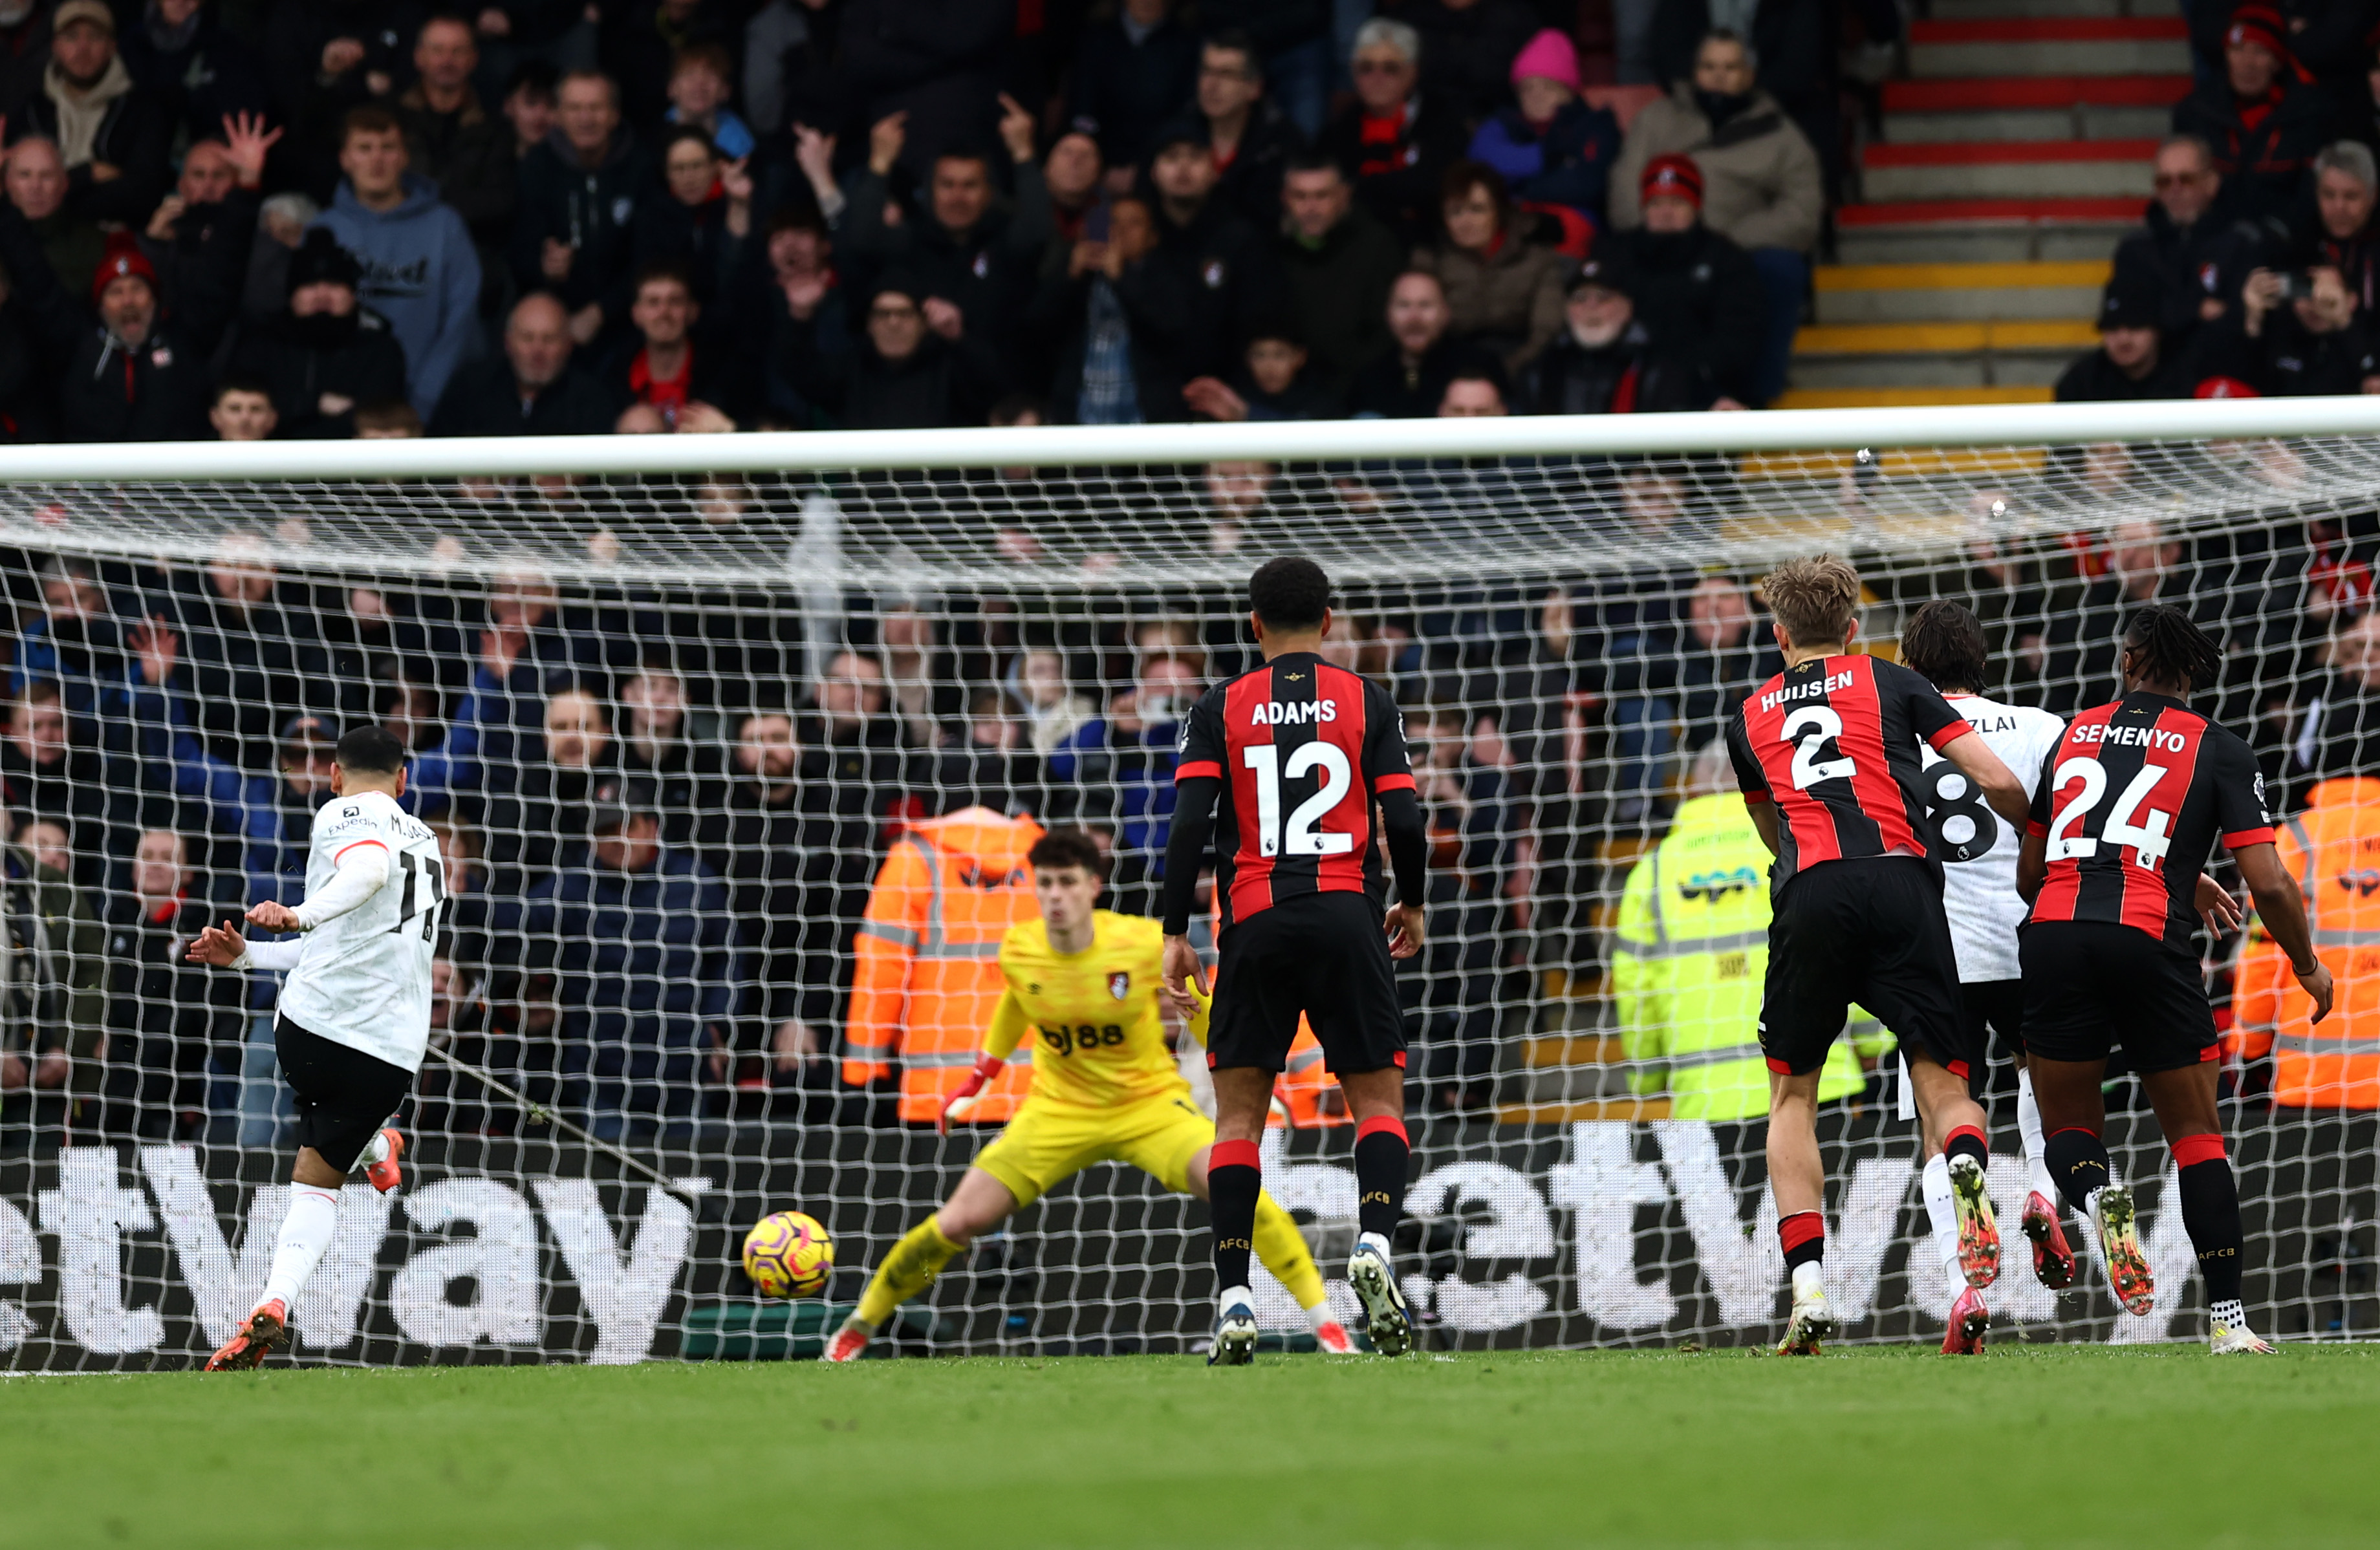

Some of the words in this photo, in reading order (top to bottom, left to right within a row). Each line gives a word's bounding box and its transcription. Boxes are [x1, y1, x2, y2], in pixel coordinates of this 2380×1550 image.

[1251, 700, 1337, 726] ADAMS
[1760, 670, 1854, 713] HUIJSEN
[1780, 705, 1857, 791] 2
[2072, 724, 2186, 753] SEMENYO
[1243, 740, 1353, 857] 12
[1922, 759, 1998, 863] 8
[2044, 756, 2171, 872] 24
[328, 817, 378, 837] Expedia
[388, 850, 444, 943] 11
[1359, 1190, 1390, 1207] AFCB
[0, 1145, 713, 1366] tway
[1218, 1237, 1250, 1253] AFCB
[2198, 1247, 2235, 1261] AFCB
